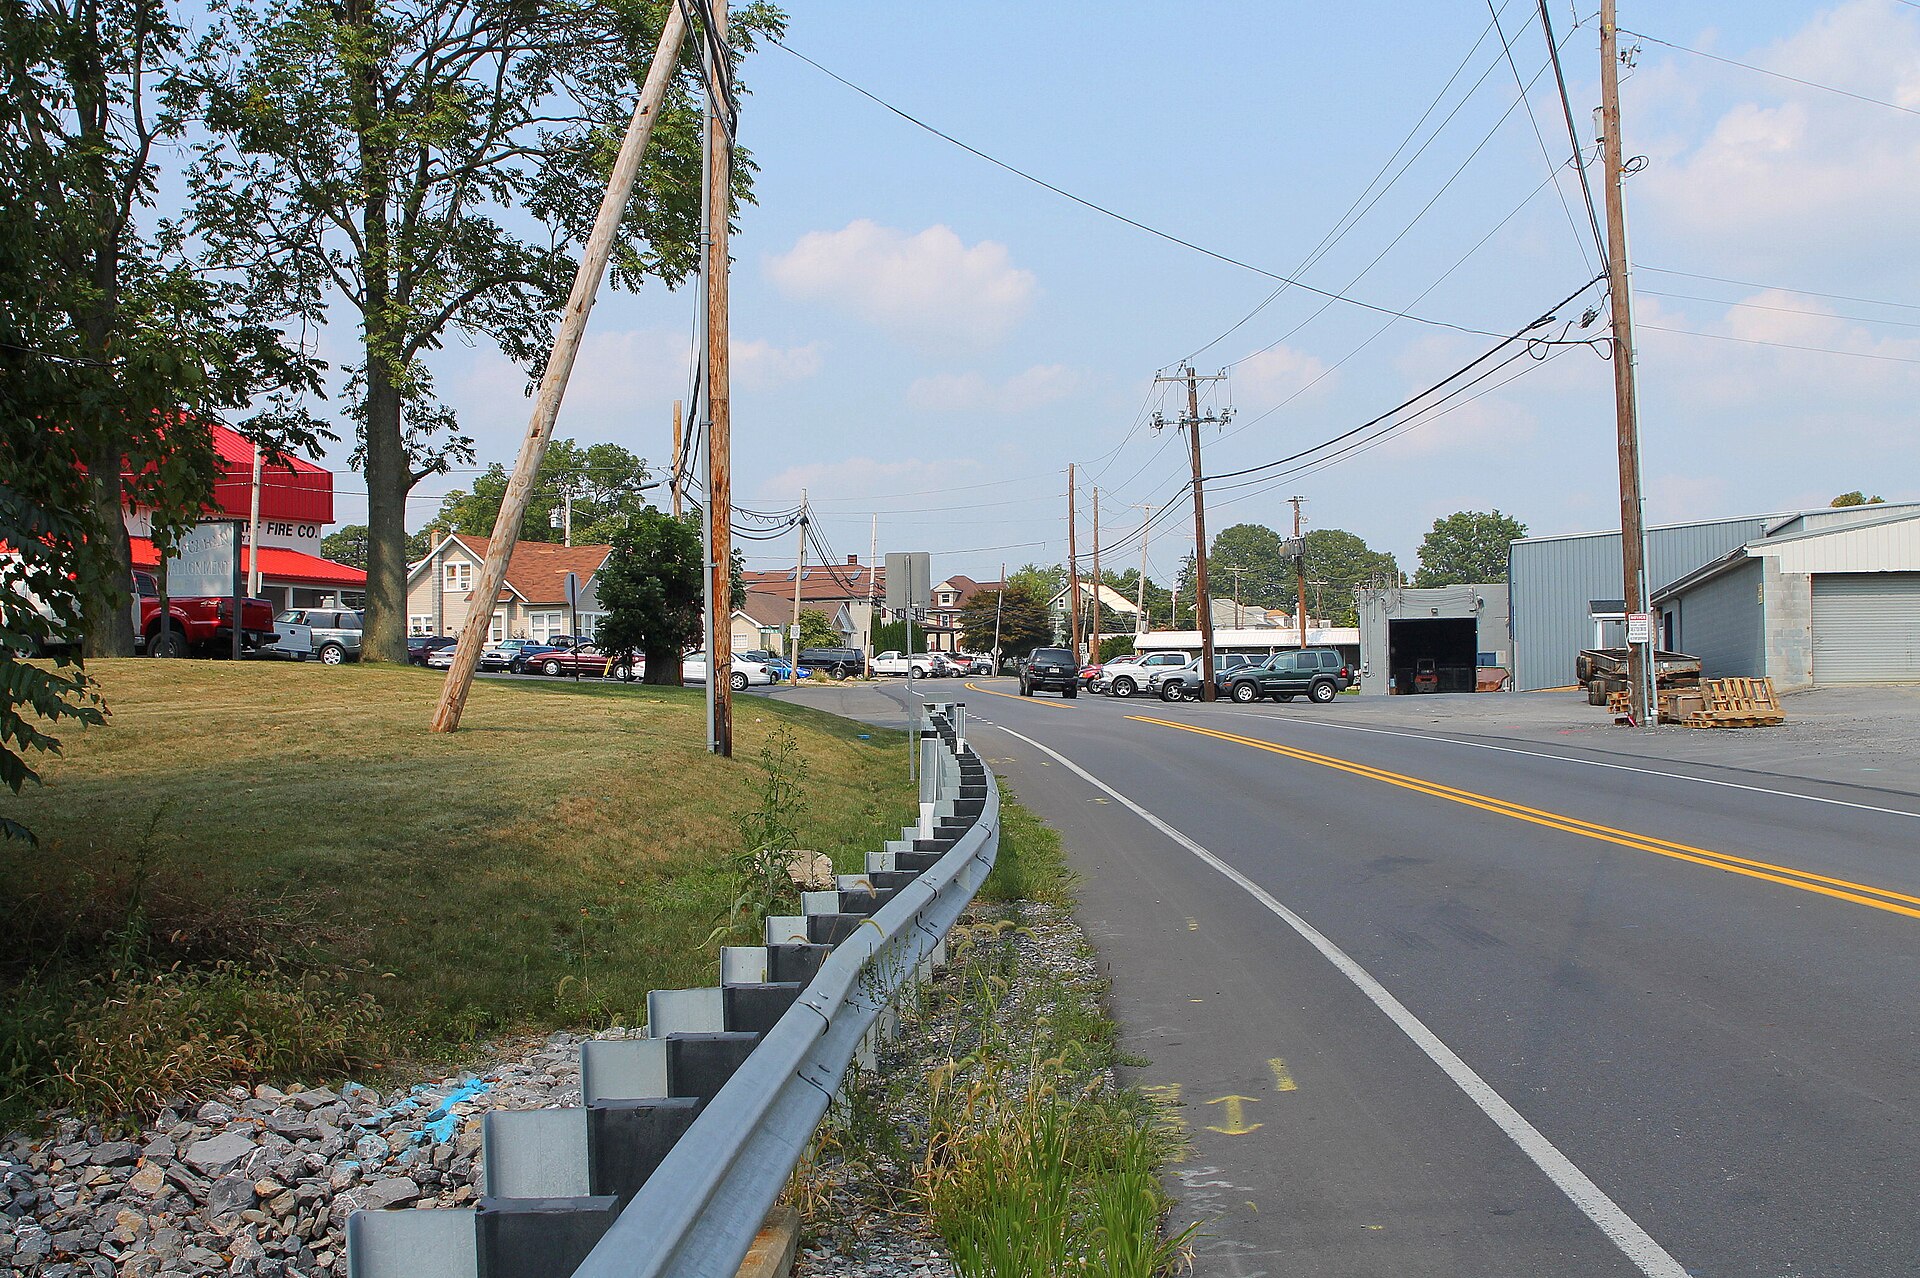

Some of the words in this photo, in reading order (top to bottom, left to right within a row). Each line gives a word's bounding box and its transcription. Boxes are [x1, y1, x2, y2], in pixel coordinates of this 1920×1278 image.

[266, 522, 293, 537] FIRE
[297, 524, 318, 539] CO.
[169, 560, 230, 576] ALIGNMENT
